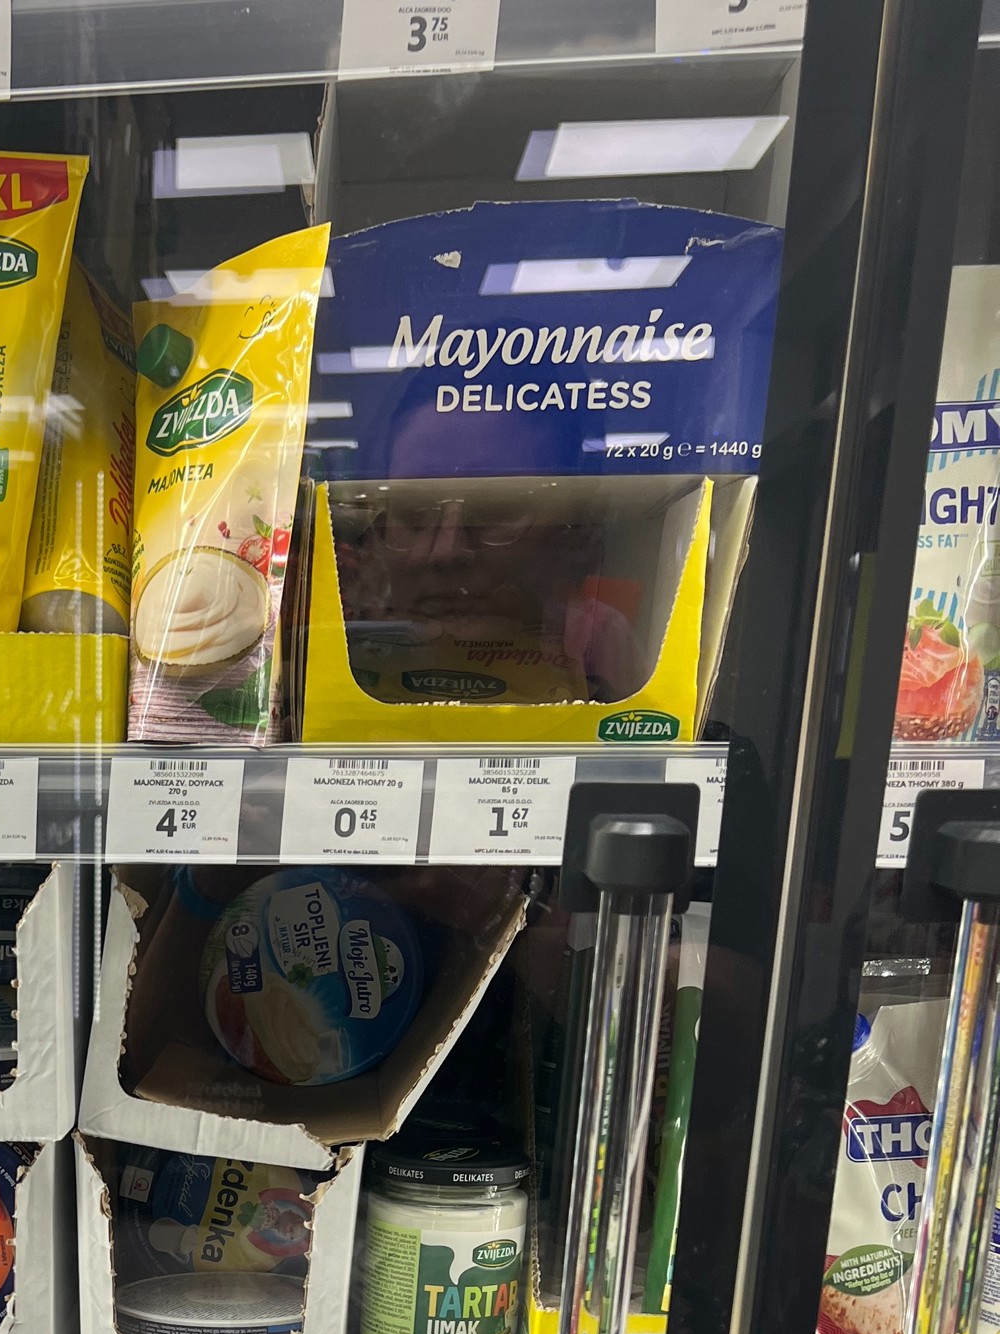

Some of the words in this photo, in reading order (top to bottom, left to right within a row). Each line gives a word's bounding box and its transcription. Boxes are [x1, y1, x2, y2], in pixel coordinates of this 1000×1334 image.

[407, 16, 427, 52] 3
[431, 17, 449, 31] 75
[387, 308, 713, 379] Mayonnaise
[436, 381, 652, 412] DELICATESS
[156, 388, 241, 439] ZVIJEZDA
[605, 443, 623, 458] 72
[626, 447, 636, 457] x
[640, 443, 659, 457] 20
[663, 445, 673, 460] g
[709, 441, 749, 457] 1440
[751, 444, 763, 459] g
[147, 462, 214, 495] MAJONEZA
[937, 534, 959, 548] FAT
[605, 721, 672, 738] ZVIJEZDA
[156, 808, 177, 837] 4
[181, 809, 197, 821] 29
[334, 807, 356, 837] 0
[360, 809, 377, 821] 45
[489, 807, 508, 836] 1
[512, 808, 529, 819] 67
[890, 811, 910, 841] 5
[292, 922, 311, 949] SIR
[304, 889, 332, 970] TOPLJENI
[348, 928, 369, 969] Moje
[347, 969, 375, 1014] Jutro
[388, 1166, 424, 1180] DELIKATES
[453, 1172, 494, 1183] DELIKATES
[476, 1246, 515, 1261] ZVIJEZDA
[840, 1257, 859, 1268] WITH
[859, 1247, 893, 1263] NATURAL
[832, 1255, 901, 1284] INGREDIENTS
[423, 1280, 519, 1320] TARTAR
